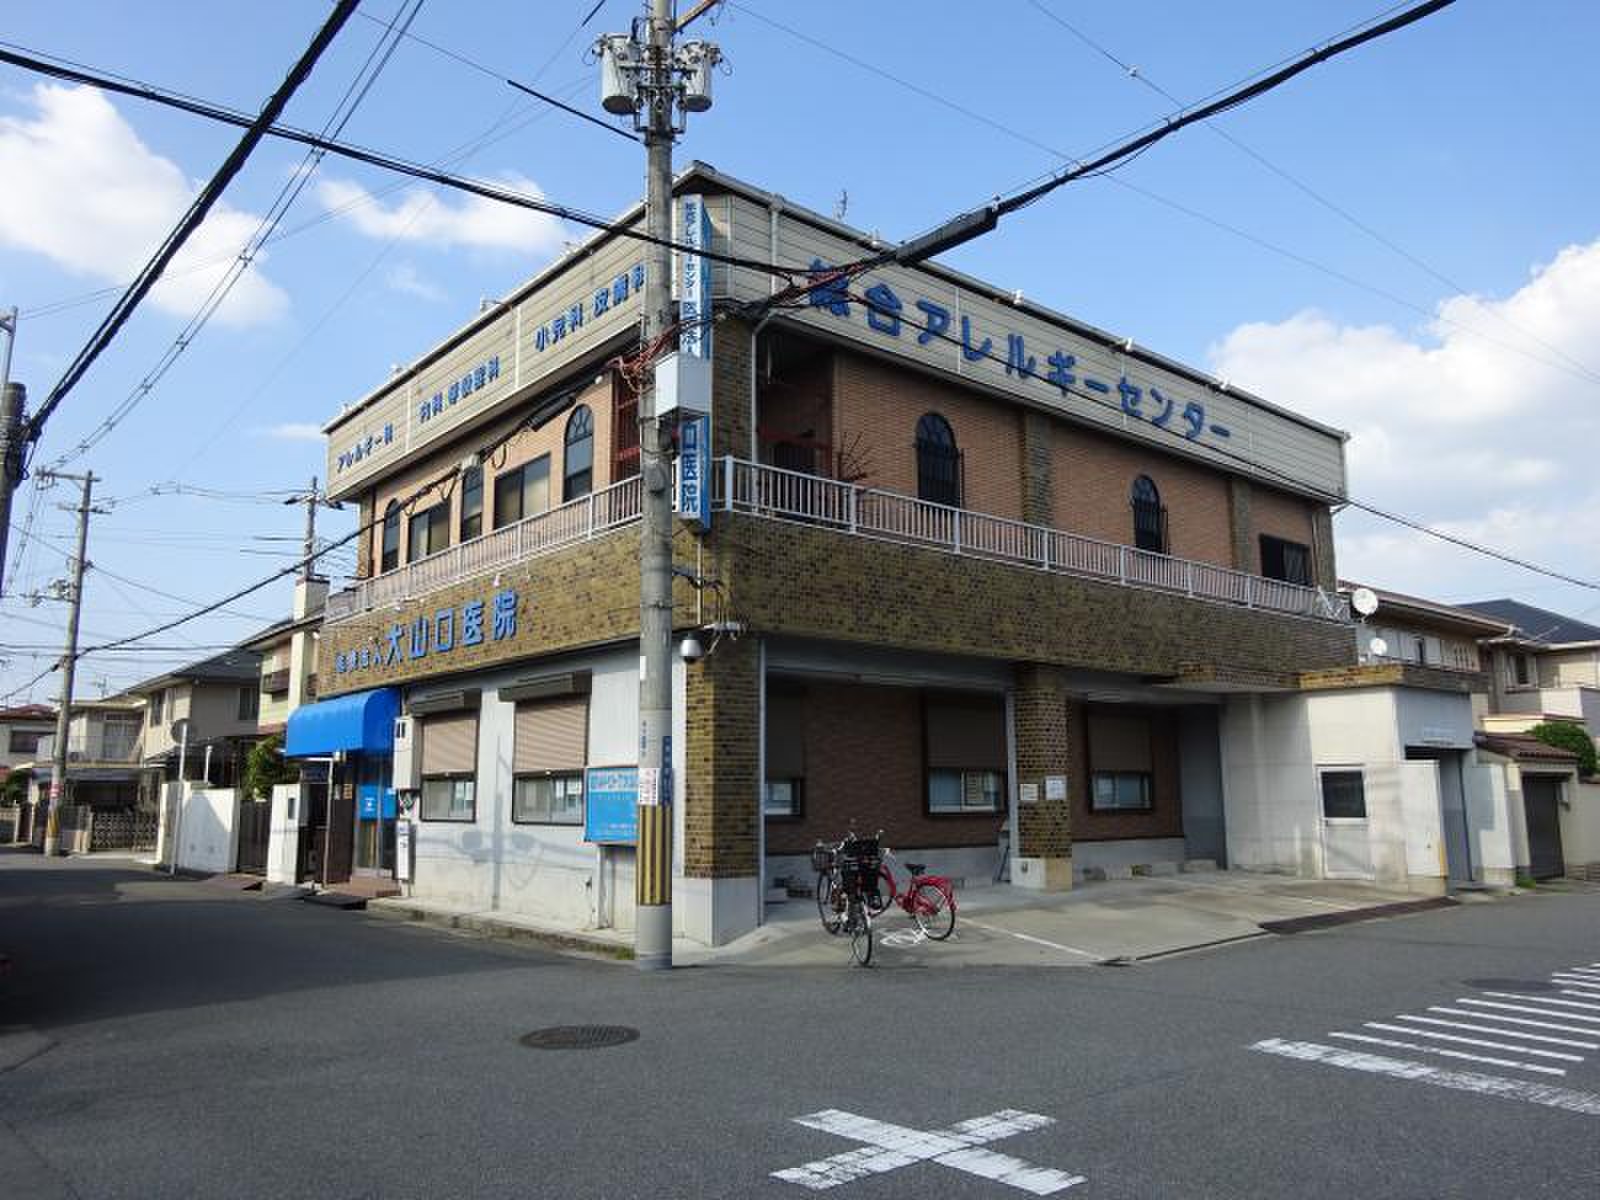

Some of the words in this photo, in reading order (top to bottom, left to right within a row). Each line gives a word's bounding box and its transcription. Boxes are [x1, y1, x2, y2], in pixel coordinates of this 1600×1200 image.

[386, 588, 519, 666] 大山口医院
